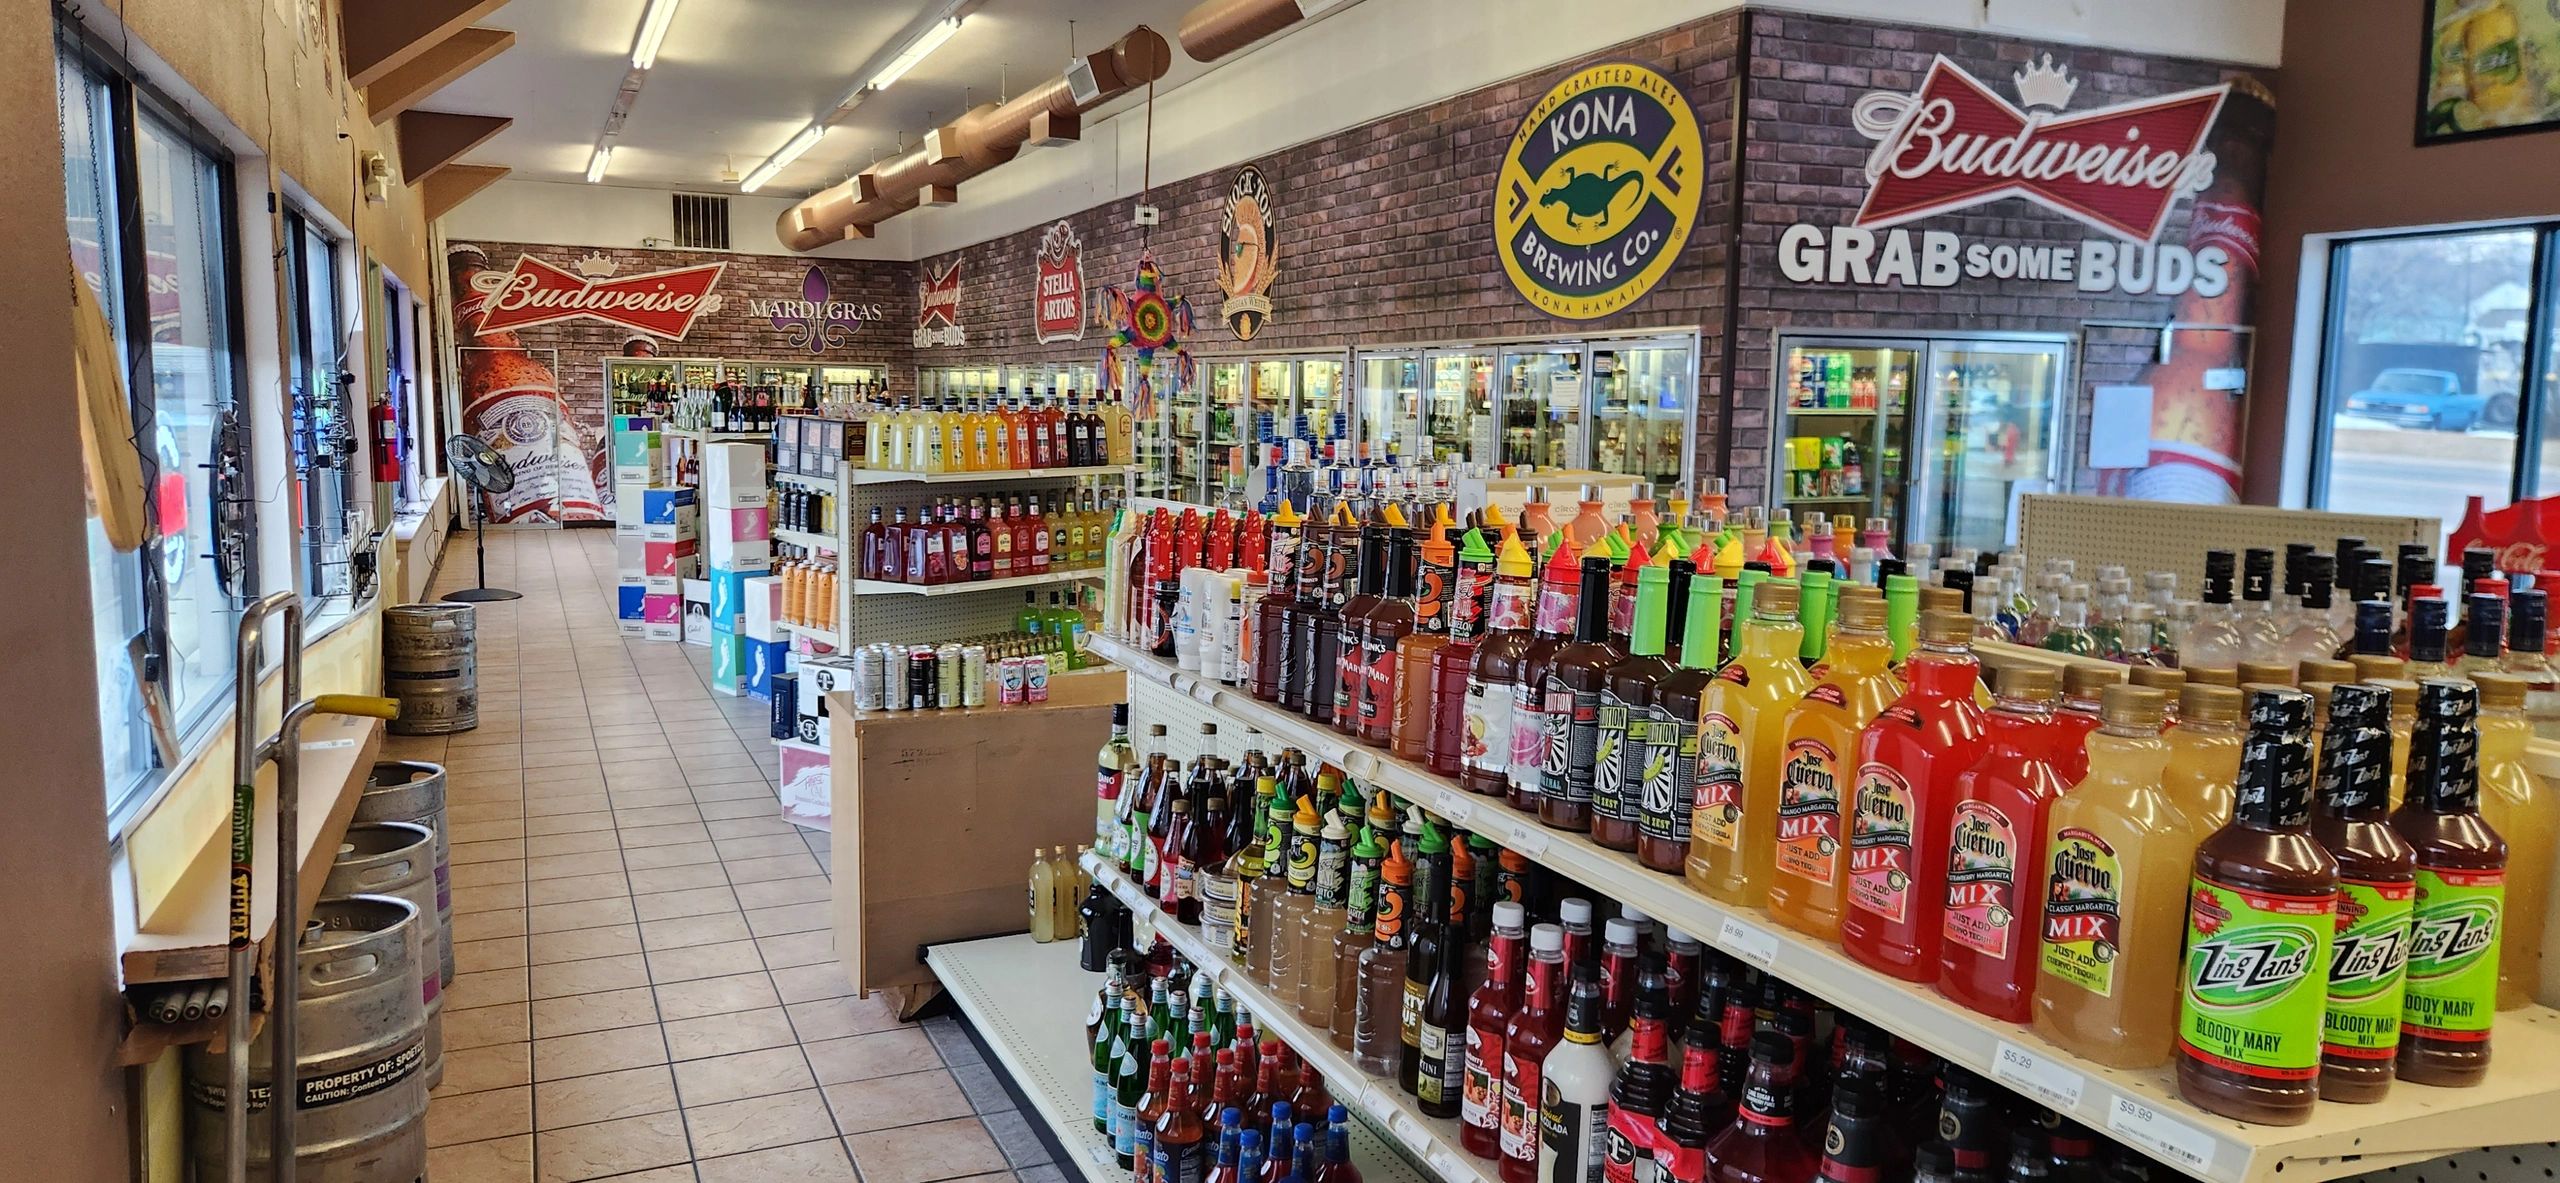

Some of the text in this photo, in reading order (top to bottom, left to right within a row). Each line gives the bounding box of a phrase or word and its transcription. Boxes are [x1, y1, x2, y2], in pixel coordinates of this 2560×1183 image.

[1518, 70, 1677, 142] HAND CRAFTED ALES
[1550, 95, 1637, 154] KONA
[1852, 89, 2218, 199] Budweiser
[1521, 230, 1618, 286] BREWING
[1777, 224, 2230, 298] GRAB SOME BUDS
[470, 271, 723, 316] Budweiser
[1043, 270, 1075, 297] STELLA
[1532, 278, 1644, 314] KONA HAWAII
[749, 299, 883, 322] MARDI GRAS
[1043, 296, 1076, 321] ARTOIS
[913, 328, 933, 349] GRAB
[944, 325, 965, 347] BUDS
[1700, 731, 1737, 763] Cuervo
[1803, 750, 1823, 767] Jose
[1786, 758, 1833, 792] Cuervo
[1696, 784, 1733, 806] MIX
[1871, 778, 1892, 797] Jose
[1782, 804, 1835, 816] MANGO MARGARITA
[1857, 785, 1904, 822] Cuervo
[1781, 815, 1831, 838] MIX
[1969, 814, 1991, 833] Jose
[1877, 834, 1908, 843] MARGARITA
[1954, 822, 2006, 859] Cuervo
[1804, 848, 1821, 861] ADD
[1851, 848, 1901, 869] MIX
[2072, 841, 2096, 864] Jose
[1976, 871, 2010, 880] MARGARITA
[2054, 849, 2112, 890] Cuervo
[1855, 876, 1890, 896] JUST ADD
[1949, 883, 2002, 906] MIX
[231, 873, 250, 943] YELLA
[2049, 902, 2115, 913] CLASSIC MARGARITA
[1724, 923, 1744, 938] $8.99
[1952, 912, 1991, 932] JUST ADD
[2049, 916, 2108, 940] MIX
[2053, 944, 2096, 968] JUST ADD
[2443, 999, 2475, 1017] MARY
[2326, 1010, 2373, 1033] BLOODY
[2424, 1016, 2443, 1027] MIX
[2196, 1016, 2282, 1053] BLOODY MARY
[2357, 1034, 2375, 1046] MIX
[2002, 1048, 2033, 1069] $5.29
[2223, 1043, 2245, 1060] MIX
[305, 1068, 376, 1093] PROPERTY
[377, 1060, 395, 1075] OF:
[304, 1087, 350, 1103] CAUTION:
[351, 1076, 387, 1094] Contents
[2119, 1099, 2154, 1122] $9.99
